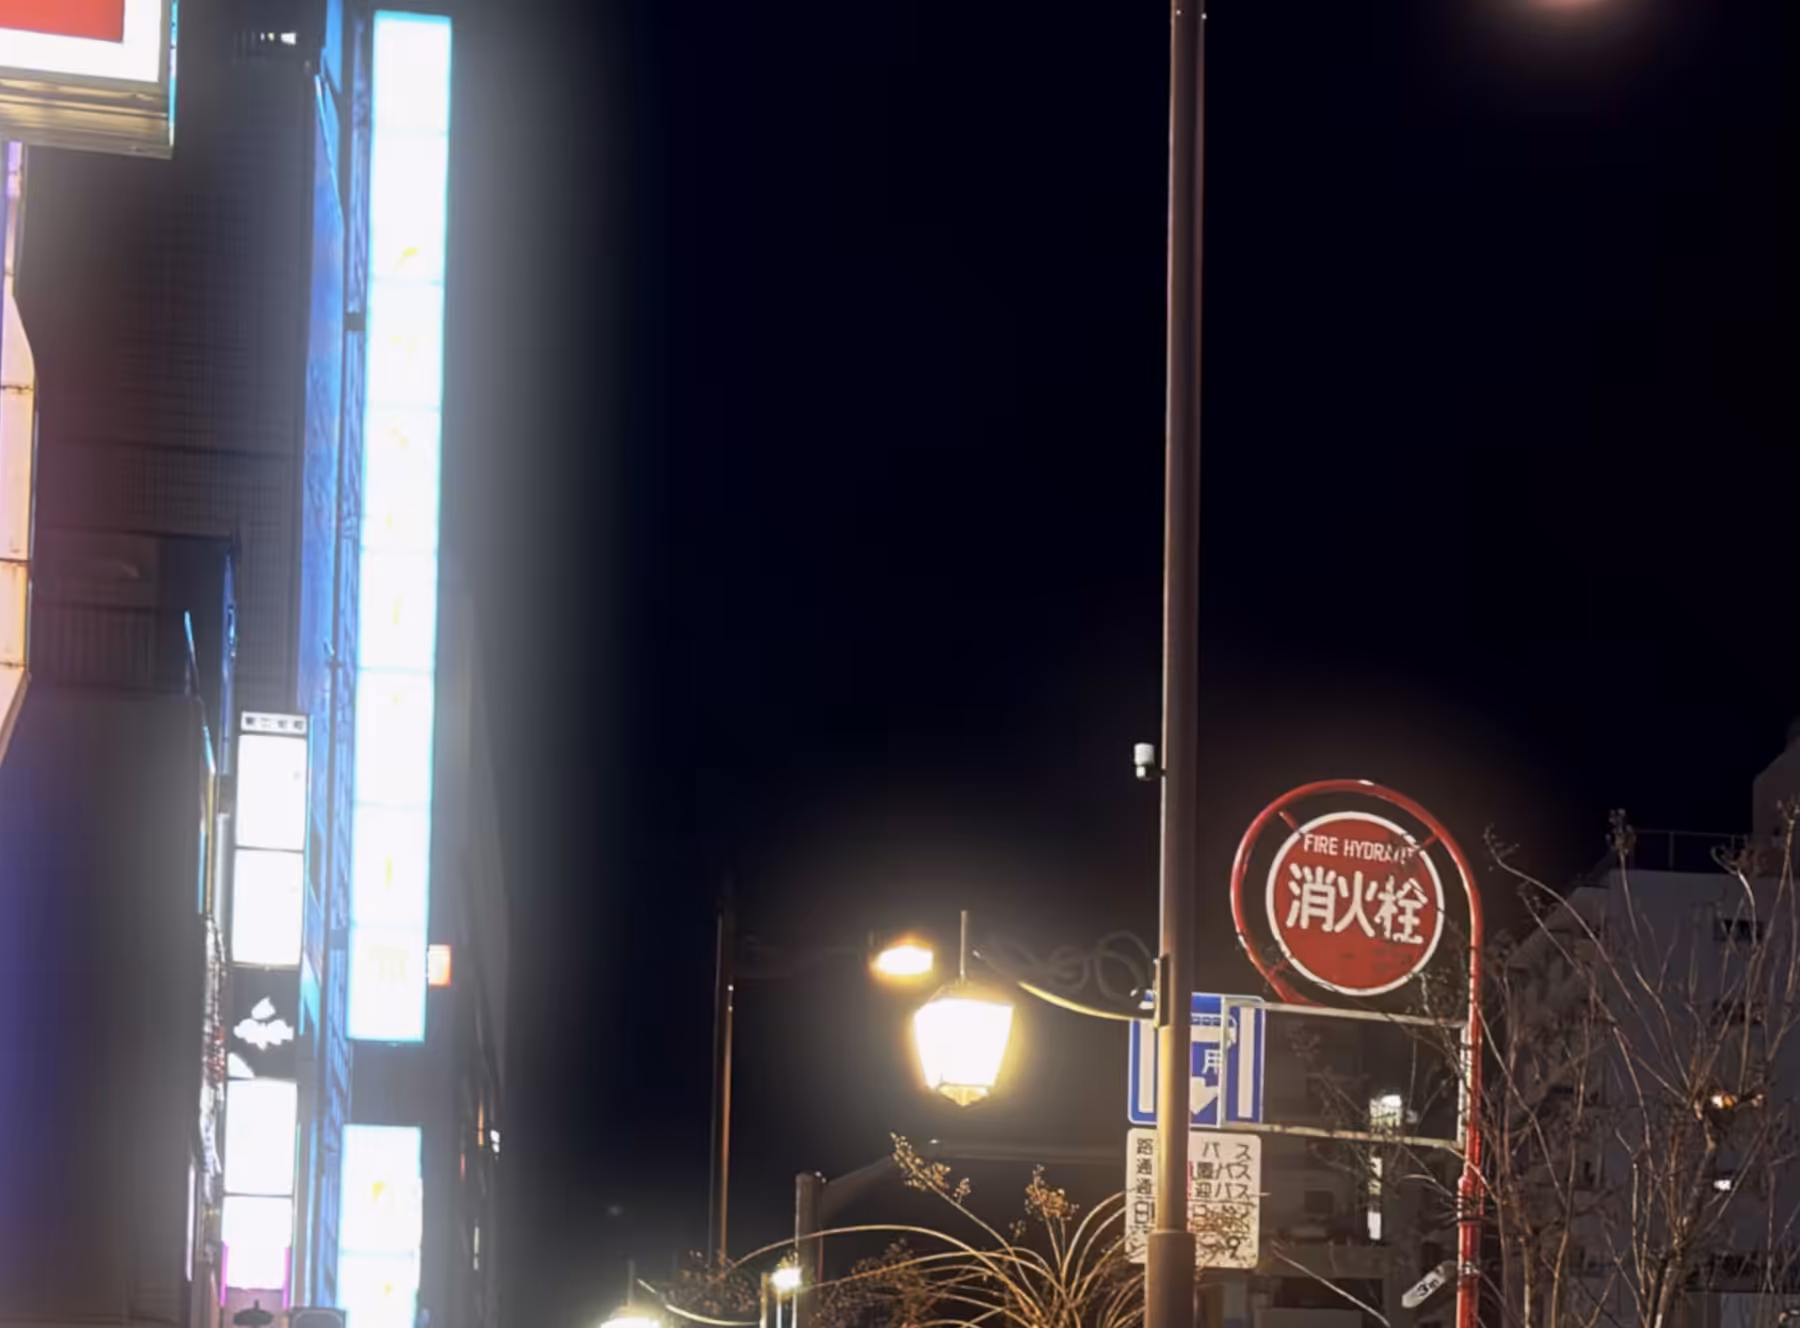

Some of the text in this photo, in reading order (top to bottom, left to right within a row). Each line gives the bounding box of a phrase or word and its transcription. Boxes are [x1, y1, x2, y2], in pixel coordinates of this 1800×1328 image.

[1304, 834, 1339, 857] FIRE
[1285, 862, 1429, 945] 消火栓
